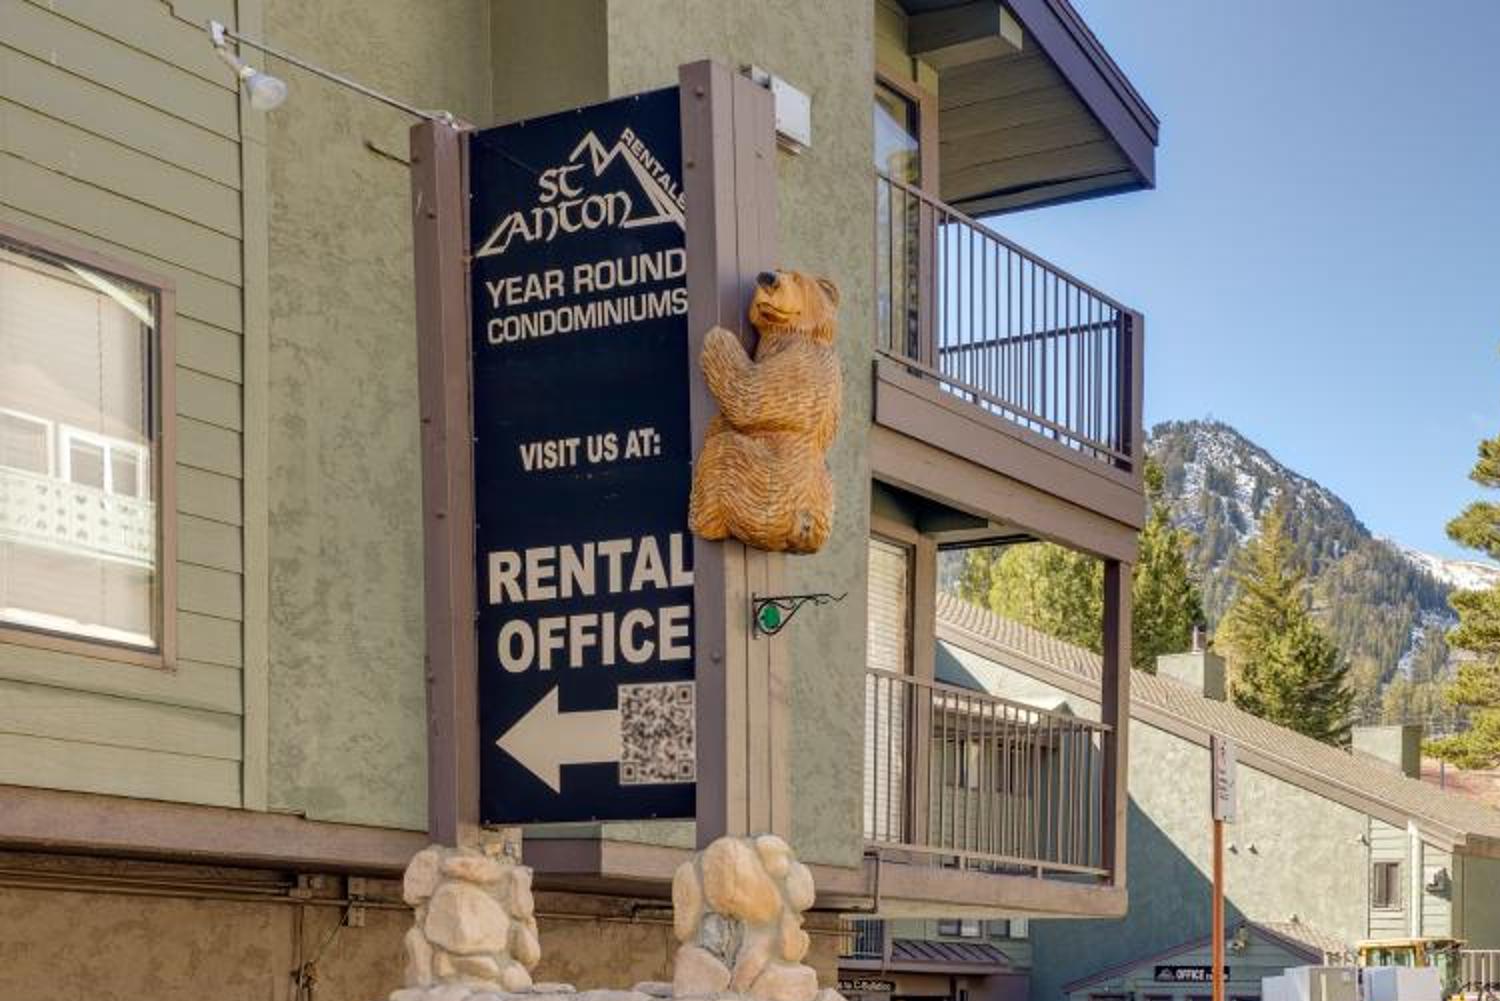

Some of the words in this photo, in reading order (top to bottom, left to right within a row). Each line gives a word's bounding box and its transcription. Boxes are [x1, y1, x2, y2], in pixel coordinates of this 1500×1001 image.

[486, 268, 565, 309] YEAR
[573, 248, 688, 294] ROUND
[487, 287, 689, 344] CONDOMINIUMS
[520, 437, 581, 472] VISIT
[587, 431, 619, 464] US
[624, 427, 661, 460] AT:
[488, 532, 695, 605] RENTAL
[497, 605, 692, 674] OFFICE
[1175, 968, 1205, 981] OFFICE
